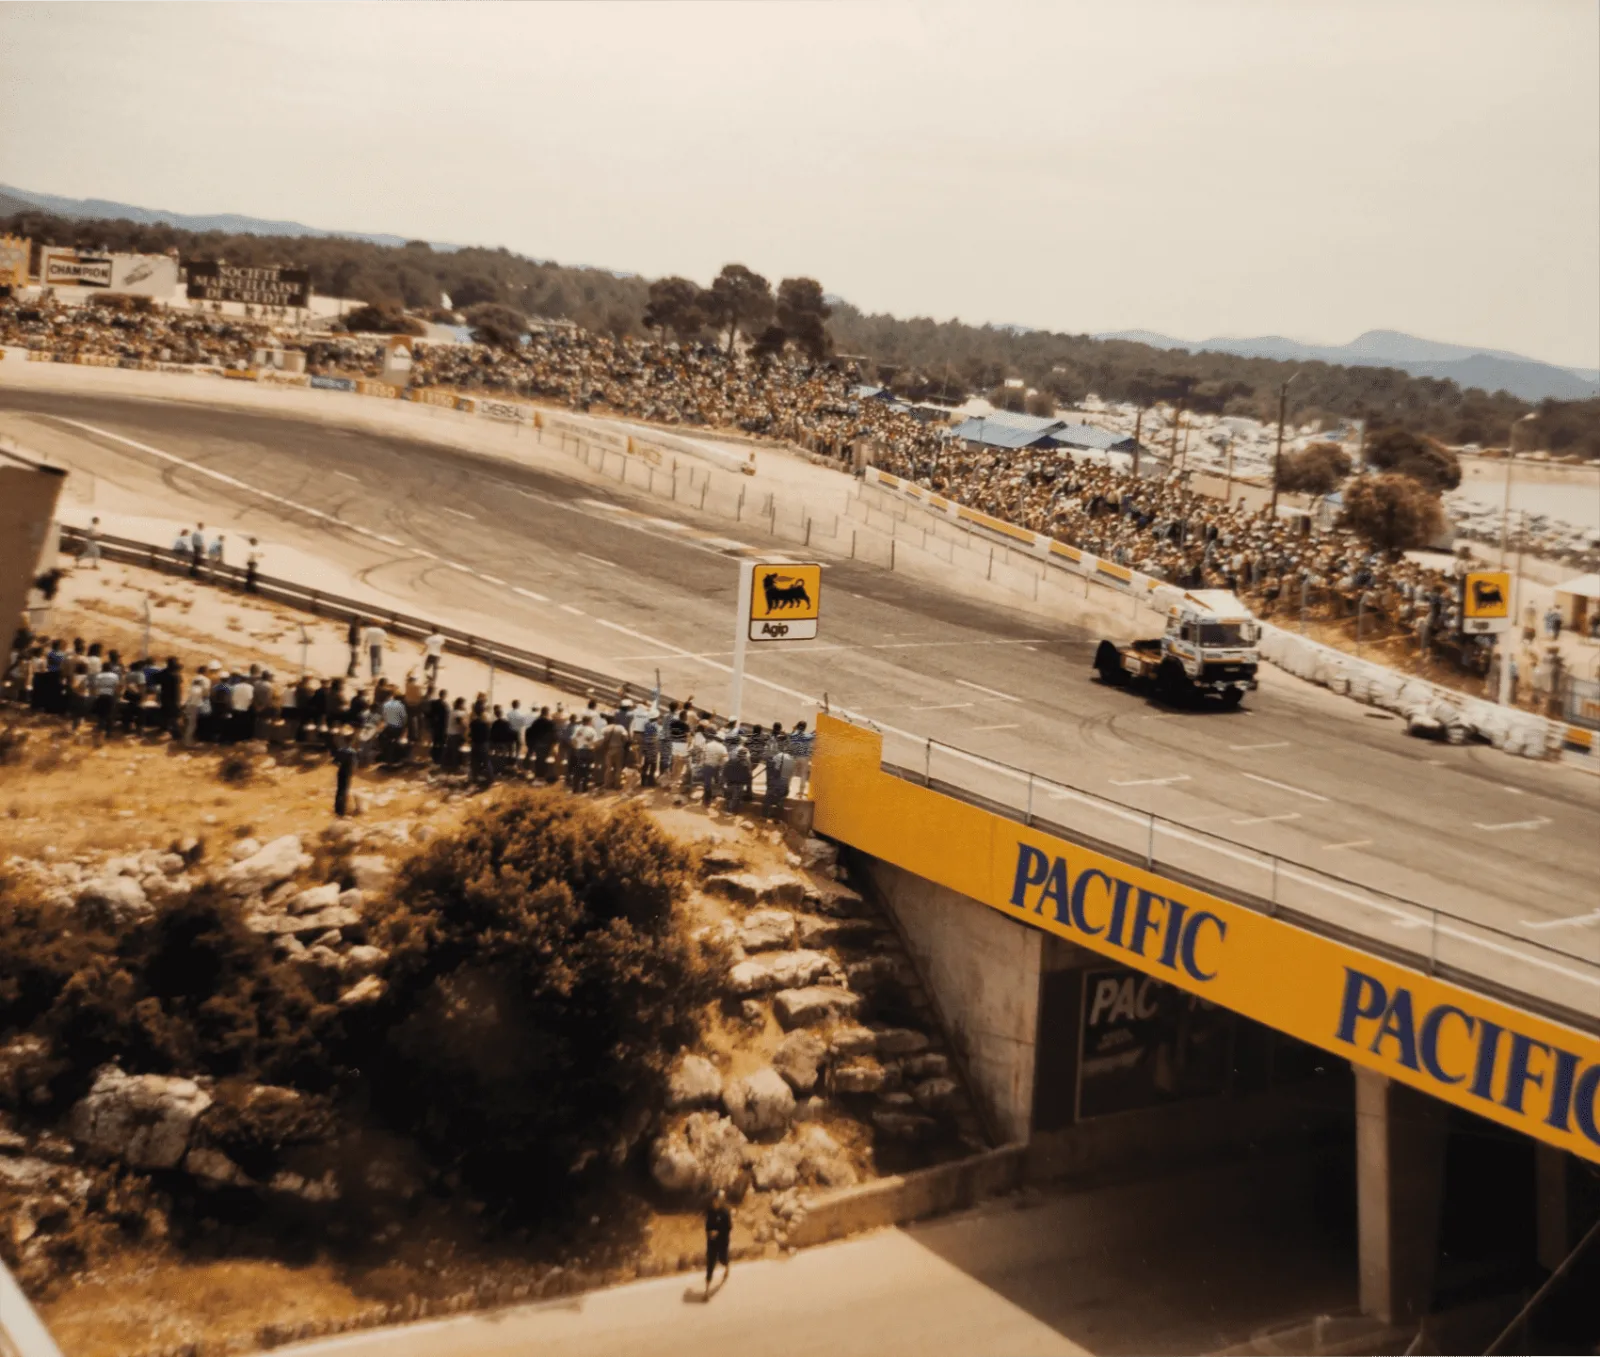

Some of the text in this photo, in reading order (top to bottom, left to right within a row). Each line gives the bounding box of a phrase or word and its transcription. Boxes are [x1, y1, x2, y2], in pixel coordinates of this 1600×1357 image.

[50, 264, 108, 278] CHAMPION
[761, 622, 789, 637] Agip
[1009, 841, 1227, 982] PACIFIC
